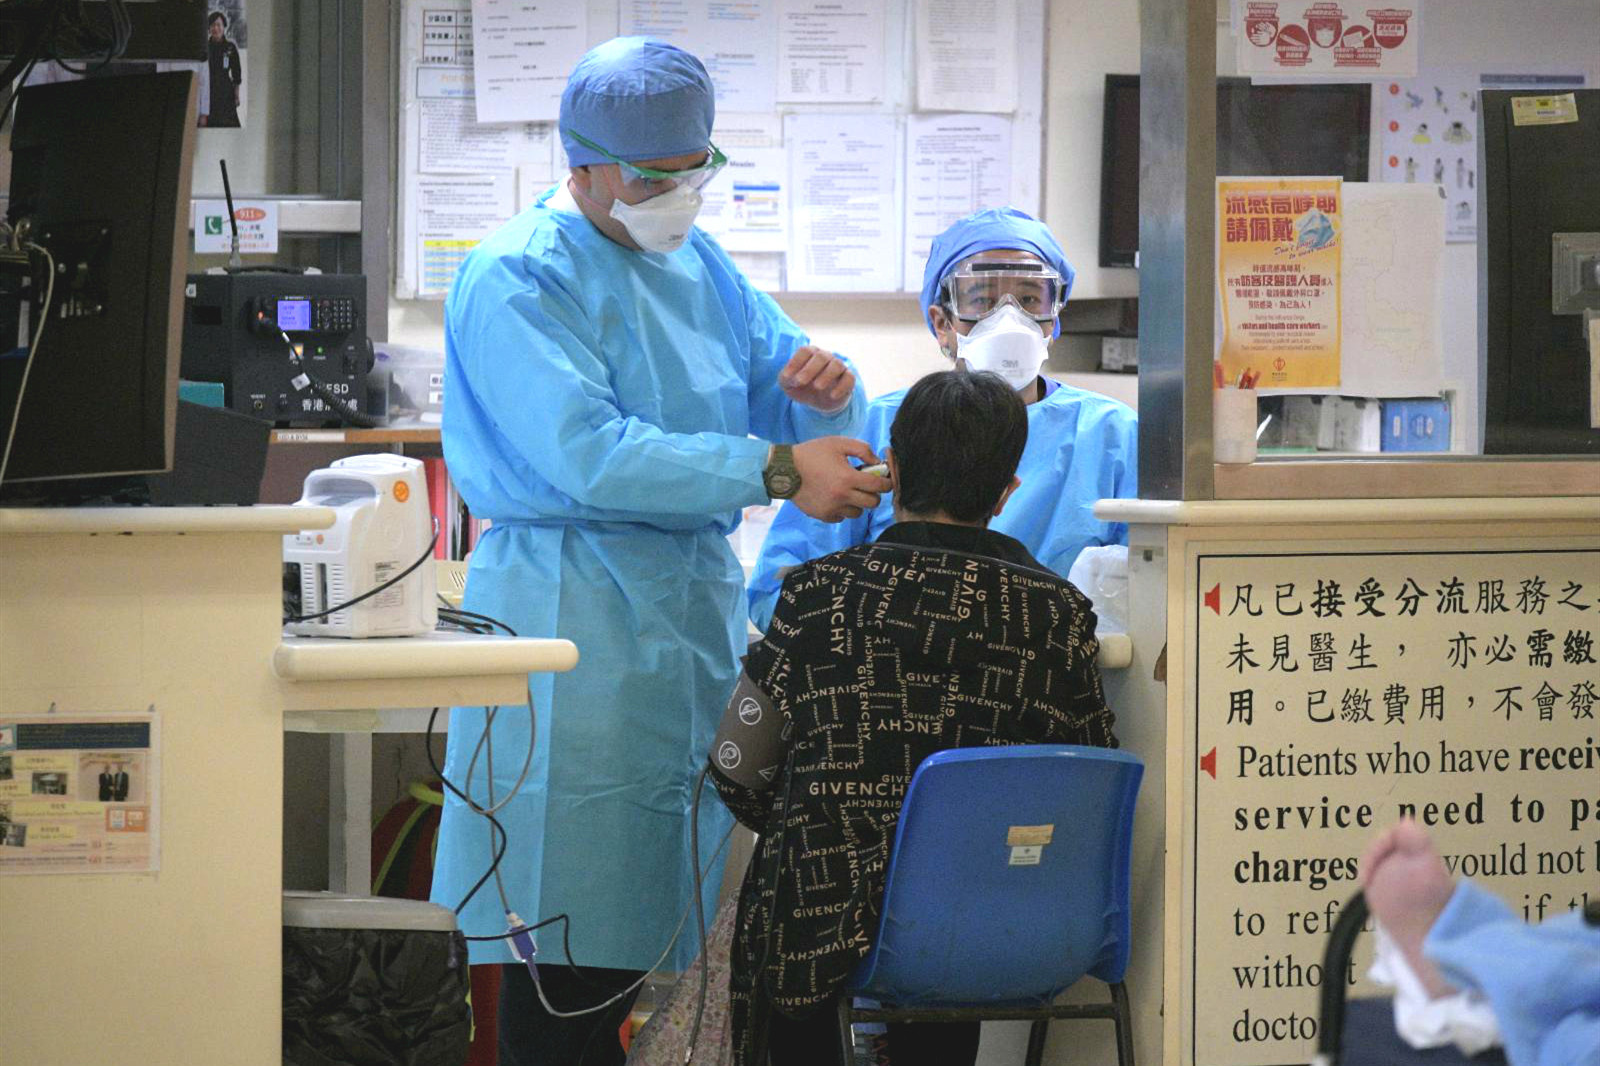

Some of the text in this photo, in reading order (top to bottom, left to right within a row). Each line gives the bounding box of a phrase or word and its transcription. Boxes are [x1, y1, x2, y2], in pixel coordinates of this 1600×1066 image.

[1225, 191, 1337, 215] 流感高峰期
[1226, 217, 1294, 242] 請佩戴
[957, 558, 980, 620] GIVEN
[1011, 573, 1056, 592] GIVENCHY
[1227, 575, 1600, 618] 凡已接受分流服務之
[795, 684, 861, 704] GIVENCHY
[857, 665, 872, 741] GIVENCHY
[957, 693, 1012, 711] GIVENCHY
[1236, 736, 1600, 778] Patients who have recei
[809, 781, 905, 796] GIVENCH
[1234, 795, 1373, 831] service
[1510, 793, 1545, 824] to
[1569, 797, 1600, 832] p
[1233, 850, 1359, 891] charges
[1536, 845, 1586, 876] not
[1233, 906, 1266, 937] to
[1523, 892, 1552, 923] if
[786, 938, 856, 961] GIVENCHY
[1232, 954, 1358, 990] withot
[1232, 1008, 1322, 1043] docto
